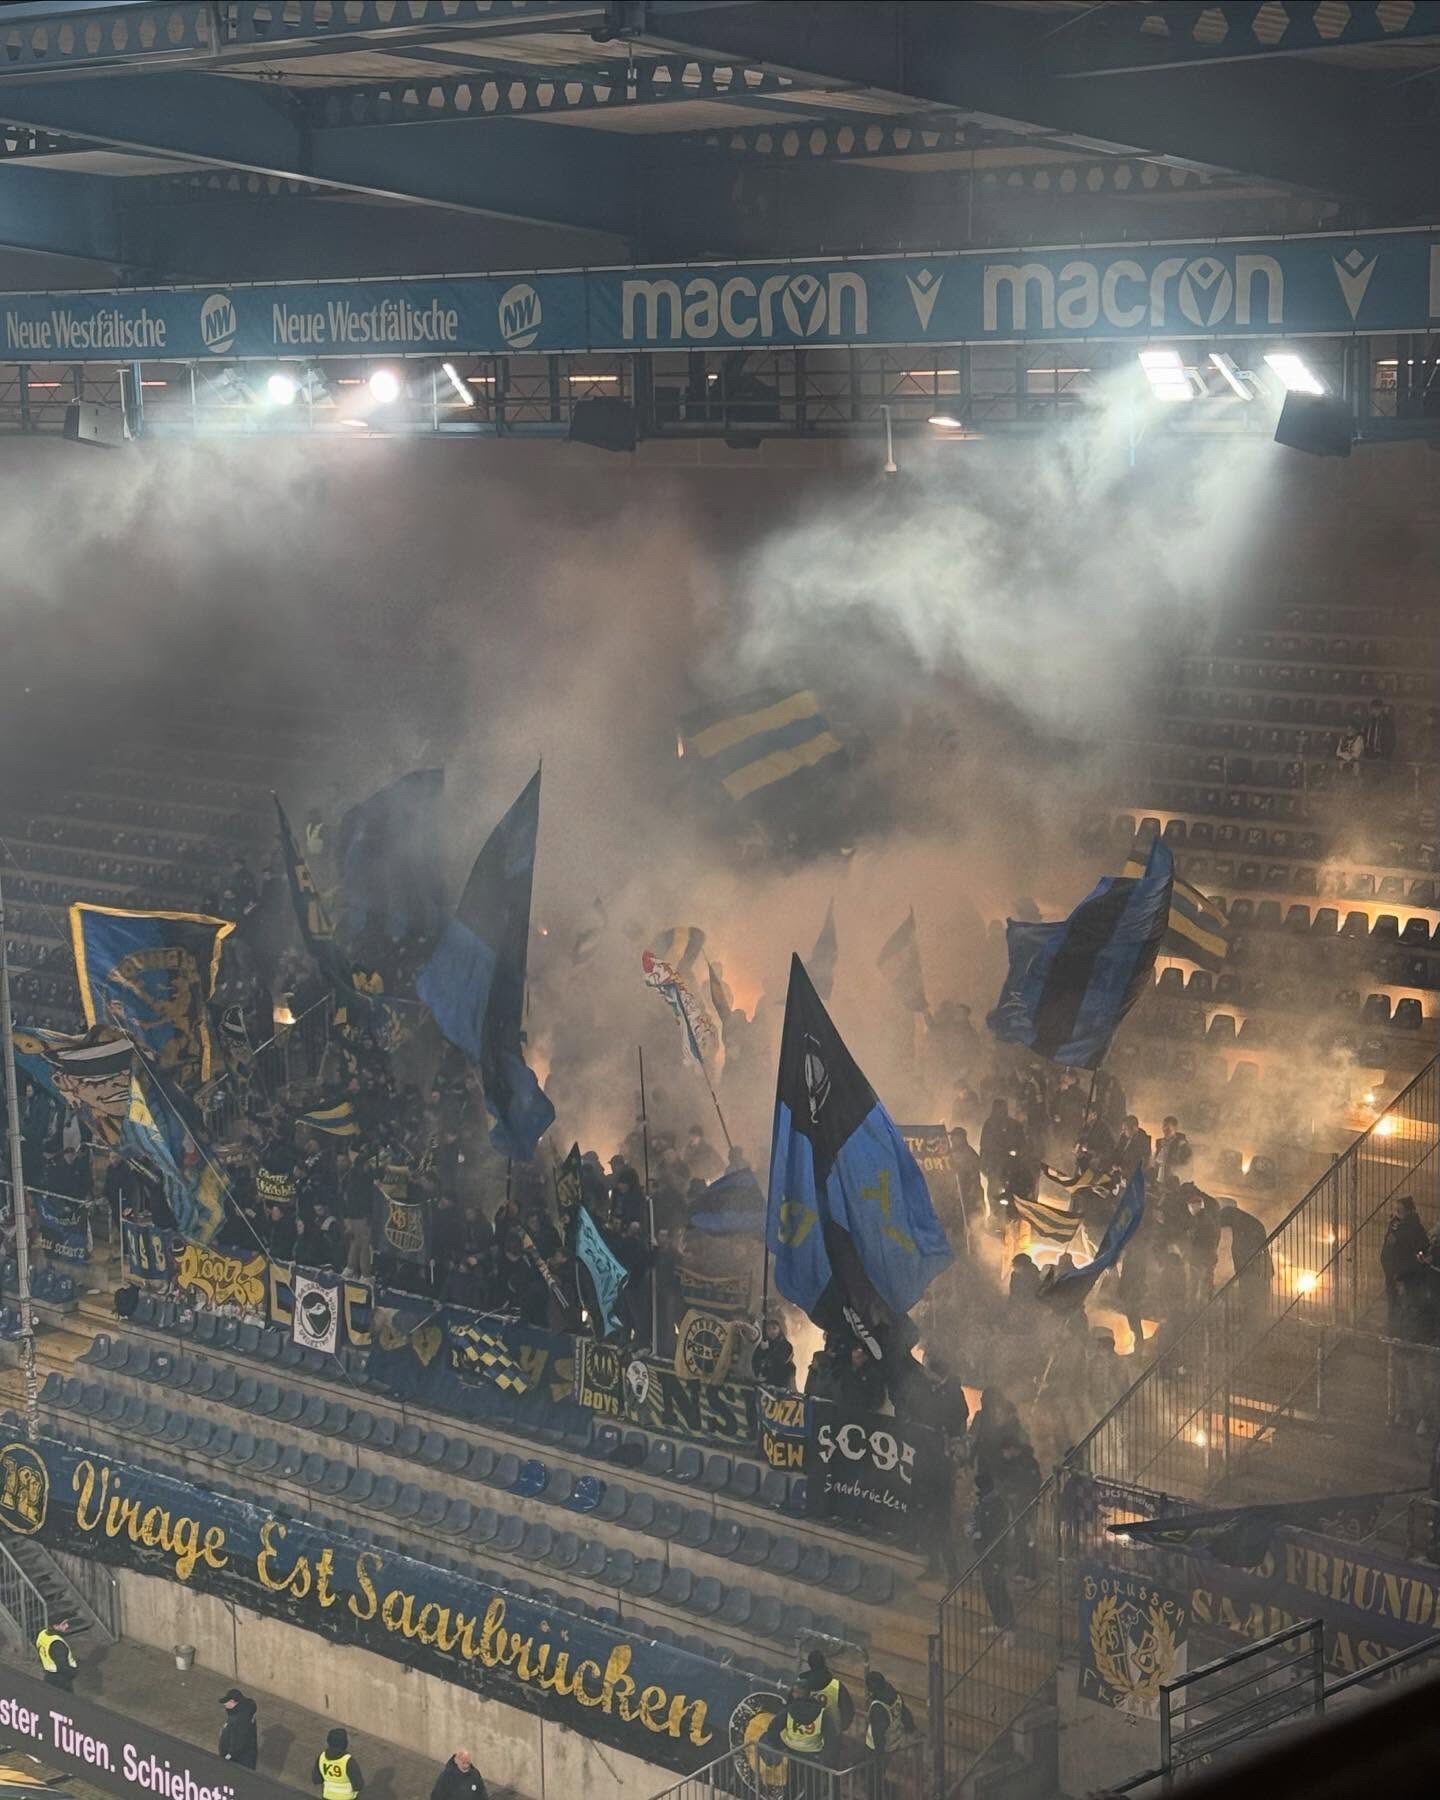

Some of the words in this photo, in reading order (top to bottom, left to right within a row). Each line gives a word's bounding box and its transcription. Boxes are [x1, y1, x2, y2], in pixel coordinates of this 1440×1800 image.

[622, 272, 868, 339] macron
[983, 254, 1284, 331] macron
[7, 312, 51, 348] Neue
[52, 308, 166, 349] Westfälische
[273, 303, 325, 344] Neue
[327, 299, 458, 342] Westfälische
[583, 1388, 619, 1416] BOYS
[72, 1461, 228, 1580] Virage
[257, 1515, 336, 1608] Est
[347, 1552, 712, 1746] Saarbrücken
[50, 1710, 116, 1773] Türen.
[323, 1763, 342, 1778] K9
